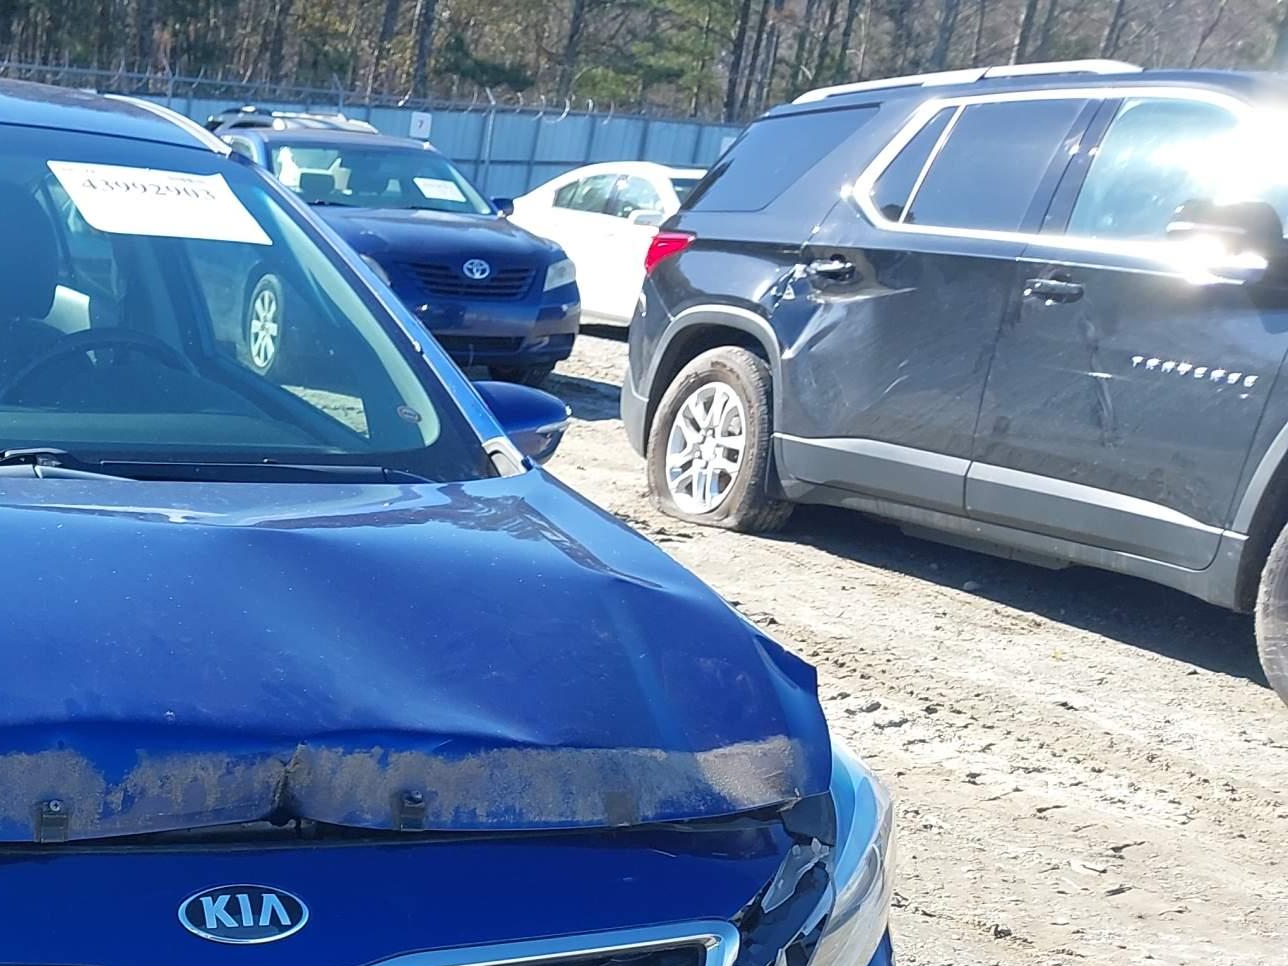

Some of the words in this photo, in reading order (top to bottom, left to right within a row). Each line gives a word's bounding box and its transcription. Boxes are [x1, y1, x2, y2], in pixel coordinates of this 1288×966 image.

[81, 177, 217, 200] 43992903
[1131, 355, 1259, 388] TRAVERSE
[199, 893, 292, 929] KIA
